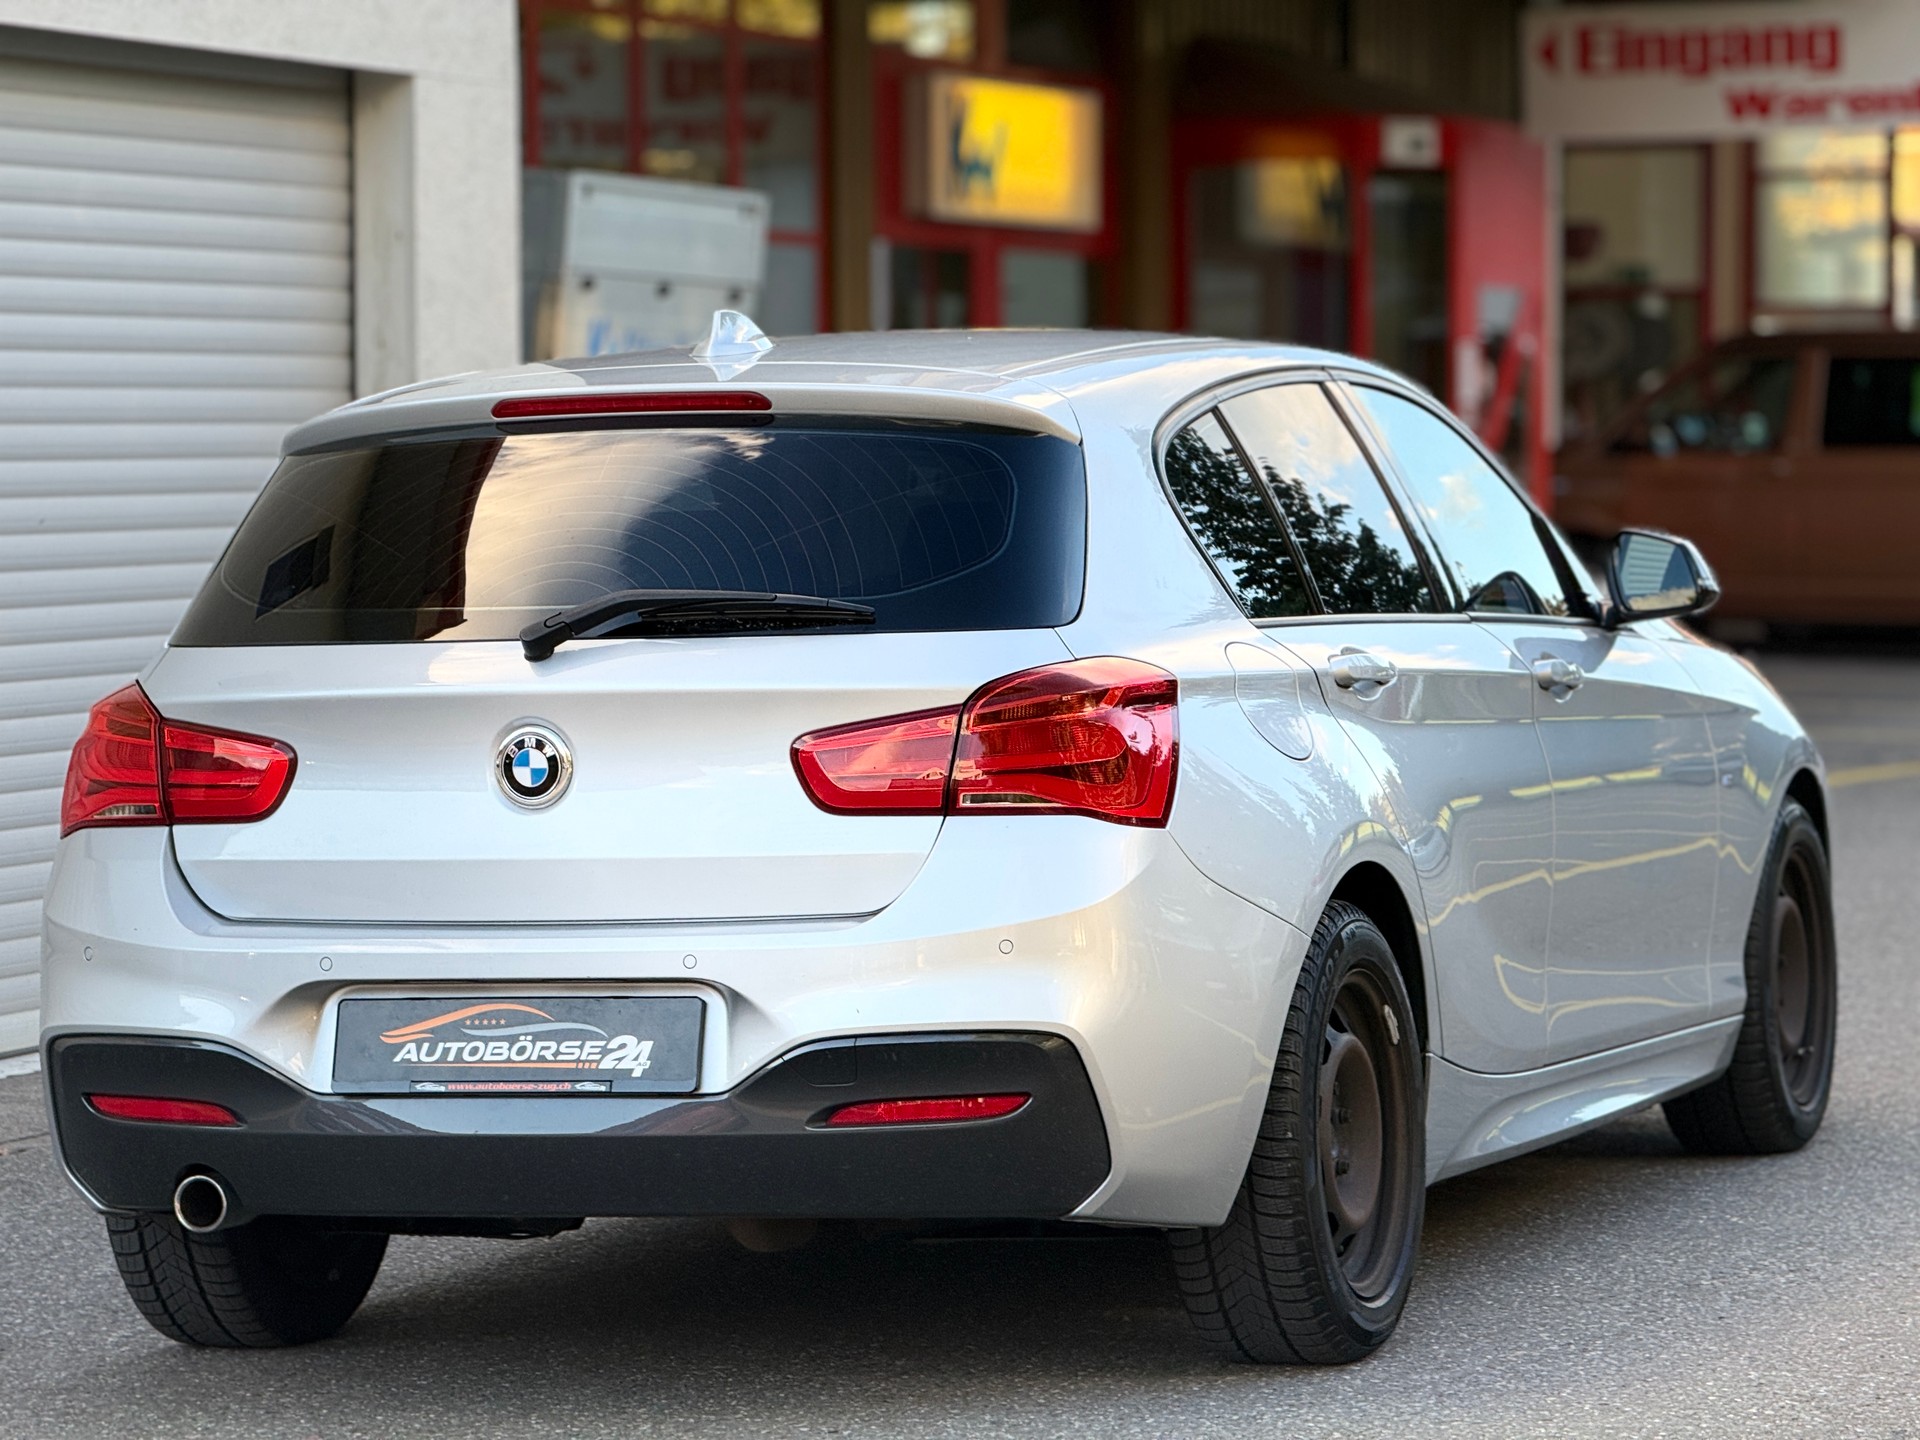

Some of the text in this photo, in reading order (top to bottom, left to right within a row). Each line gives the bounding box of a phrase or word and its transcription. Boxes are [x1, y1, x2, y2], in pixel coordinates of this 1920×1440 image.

[1576, 24, 1843, 78] Eingang
[1725, 80, 1920, 121] Waren
[508, 737, 555, 758] BMW
[447, 1081, 572, 1092] www.autoboerse-zug.ch
